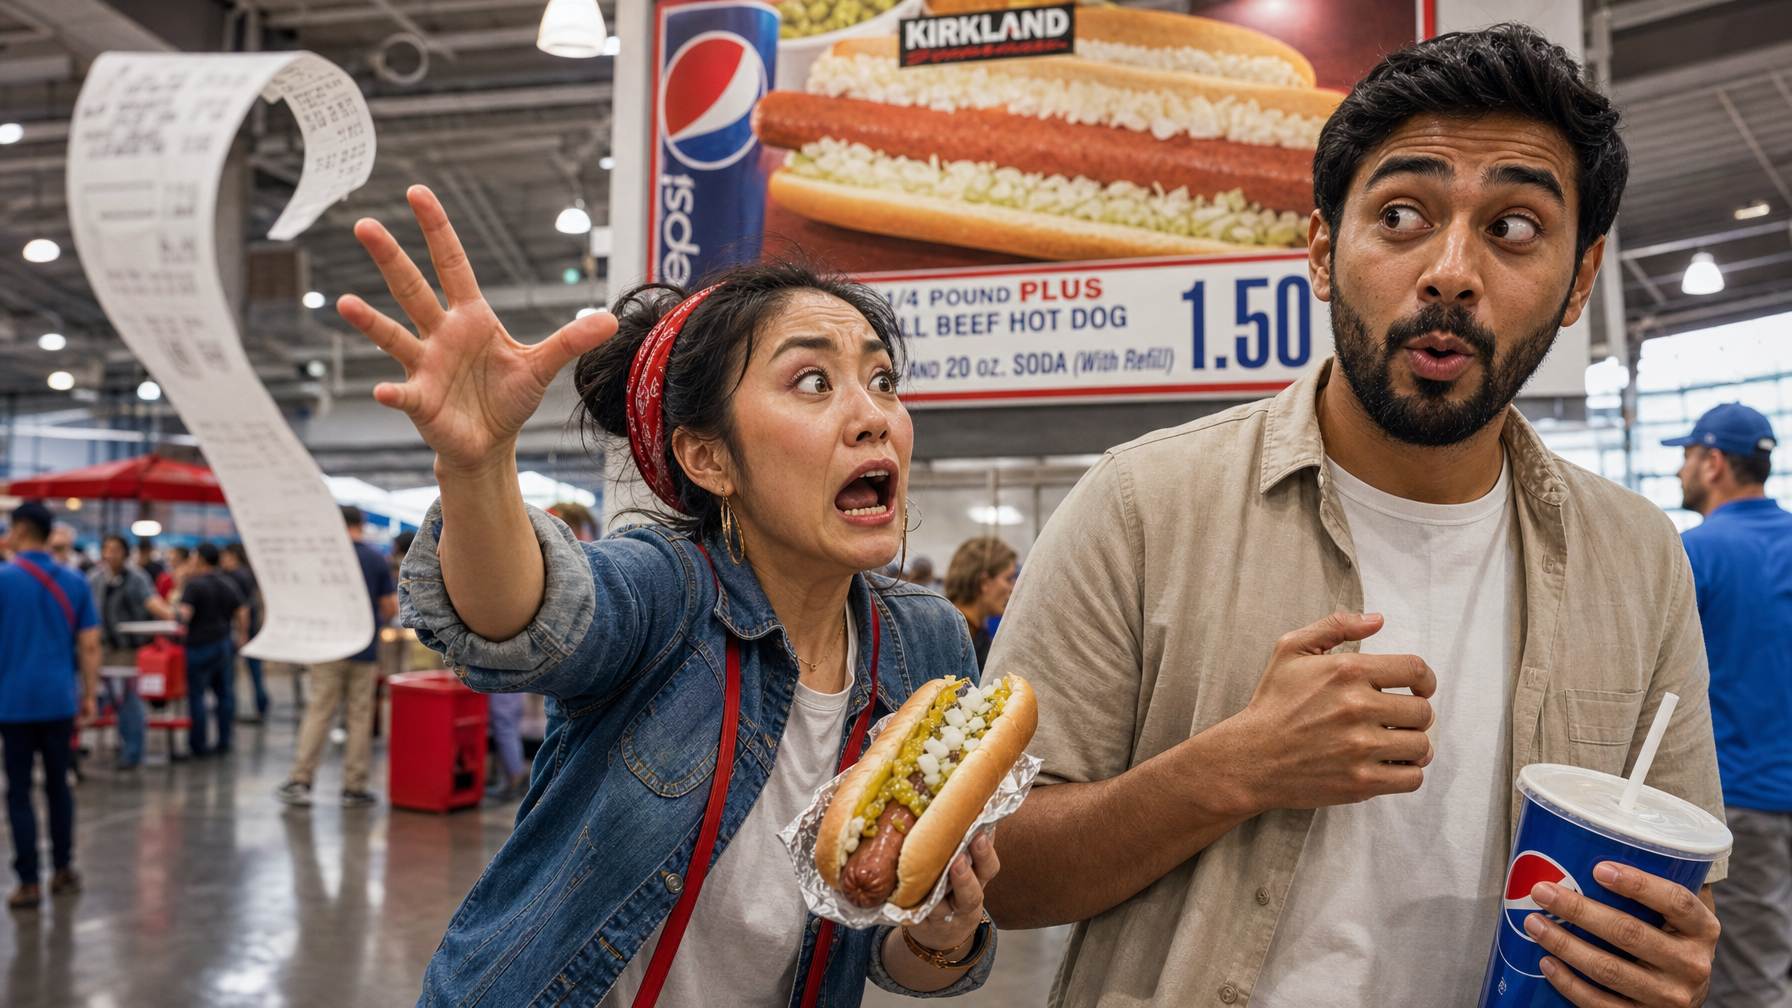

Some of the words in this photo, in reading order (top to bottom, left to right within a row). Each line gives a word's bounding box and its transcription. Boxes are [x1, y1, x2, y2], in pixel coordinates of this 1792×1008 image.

[905, 7, 1070, 50] KIRKLAND
[661, 173, 700, 289] epsi
[887, 288, 919, 309] 1/4
[930, 287, 1011, 307] POUND
[1020, 278, 1103, 303] PLUS
[891, 316, 927, 338] LL
[937, 312, 1000, 337] BEEF
[1009, 309, 1061, 333] HOT
[1071, 305, 1127, 330] DOG
[1182, 275, 1311, 370] 1.50
[946, 355, 971, 379] 20
[1013, 352, 1067, 376] SODA
